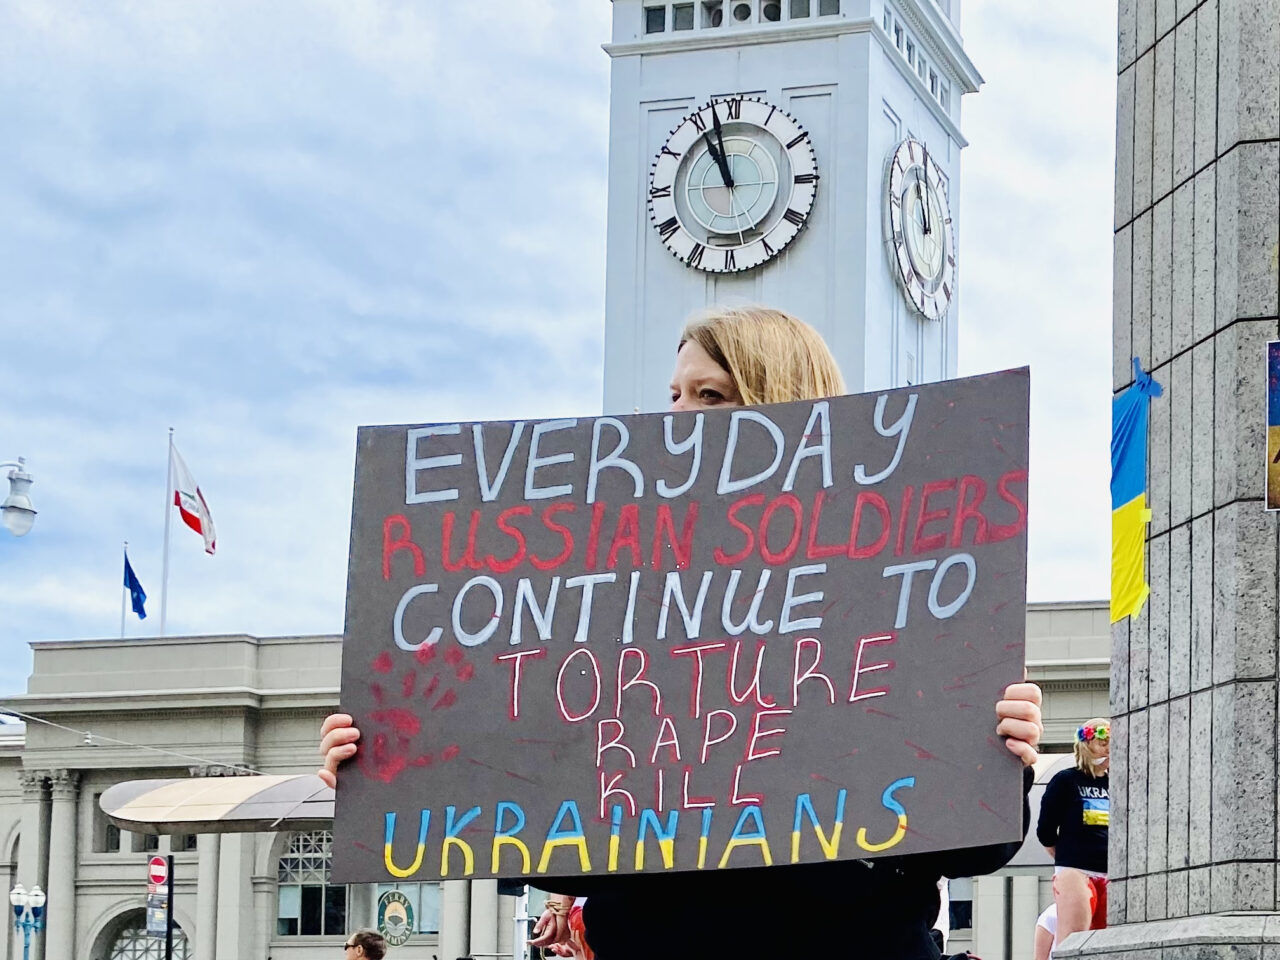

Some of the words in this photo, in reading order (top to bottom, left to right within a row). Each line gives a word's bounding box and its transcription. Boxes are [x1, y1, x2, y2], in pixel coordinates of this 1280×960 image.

[381, 502, 699, 580] RUSSIAN
[714, 468, 1028, 568] SOLDIERS
[393, 563, 830, 653] CONTINUE
[882, 552, 978, 629] TO
[498, 635, 894, 722] TORTURE
[595, 709, 793, 769] RAPE
[384, 776, 915, 878] UKRAINIANS
[599, 764, 763, 820] KILL
[384, 892, 409, 908] FERRY
